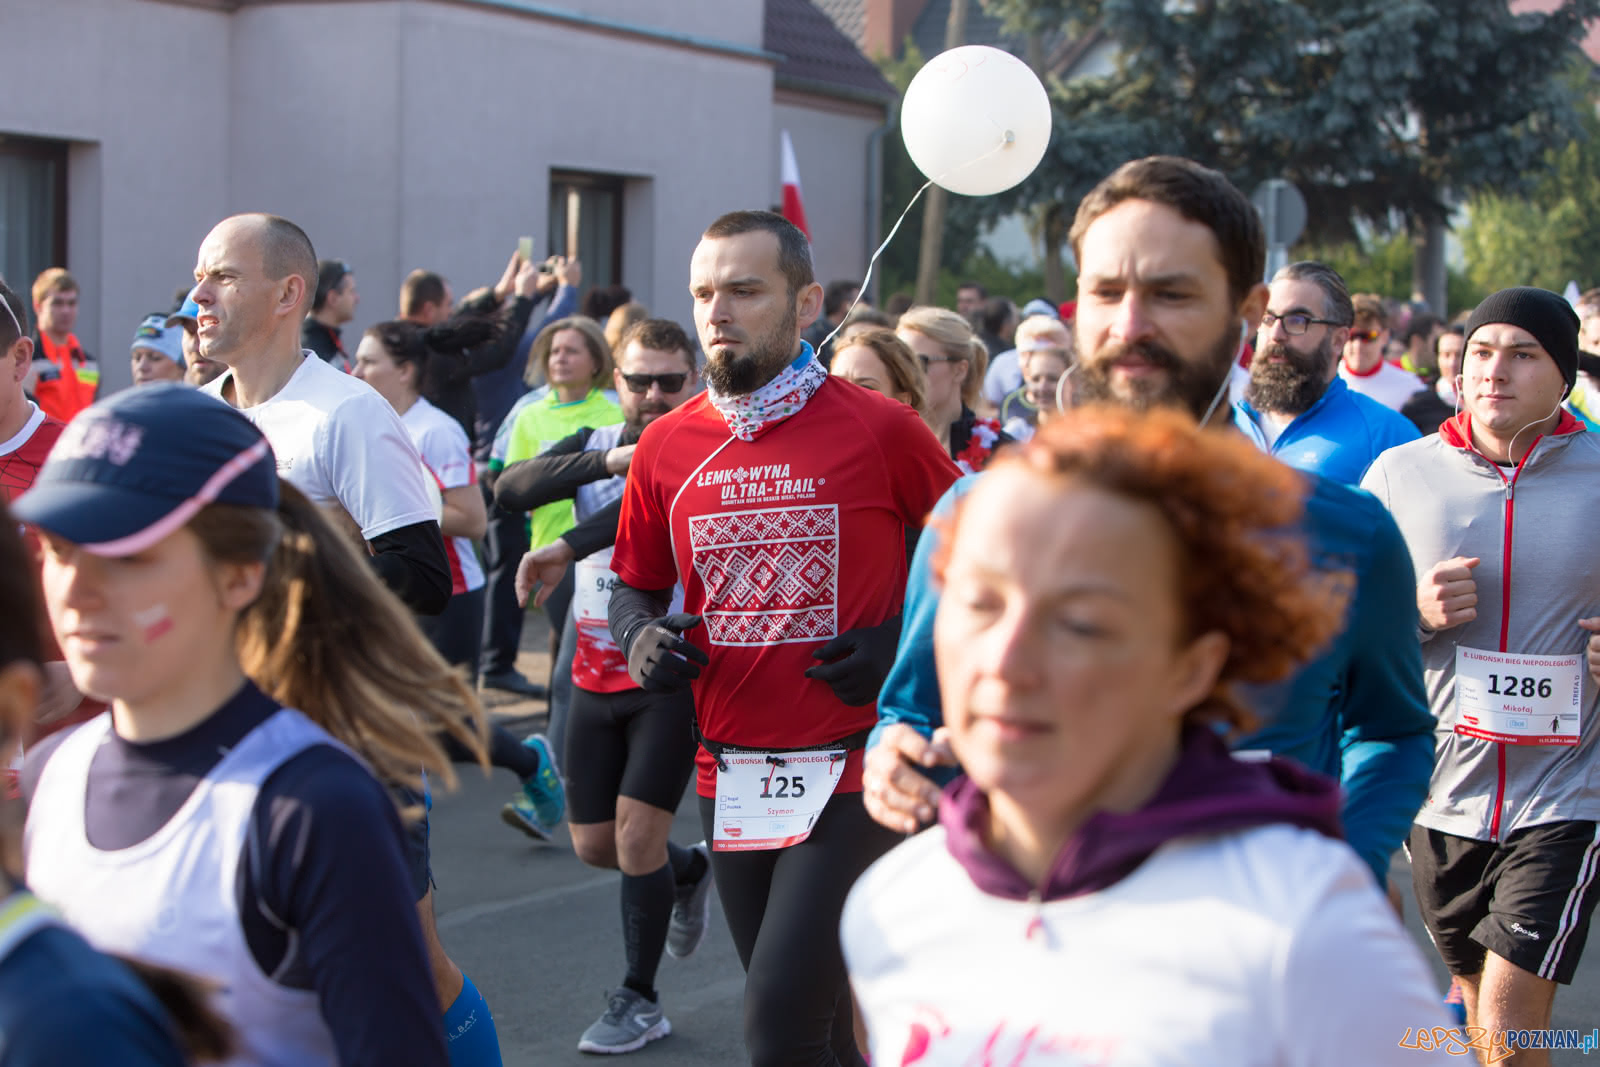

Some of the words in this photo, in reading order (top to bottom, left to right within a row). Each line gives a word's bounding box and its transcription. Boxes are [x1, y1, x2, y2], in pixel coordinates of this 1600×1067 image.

[721, 478, 816, 499] ULTRA-TRAIL
[596, 577, 614, 592] 94
[1488, 674, 1552, 698] 1286
[1503, 704, 1533, 714] Mikołaj
[760, 776, 805, 798] 125
[767, 807, 794, 816] Szymon
